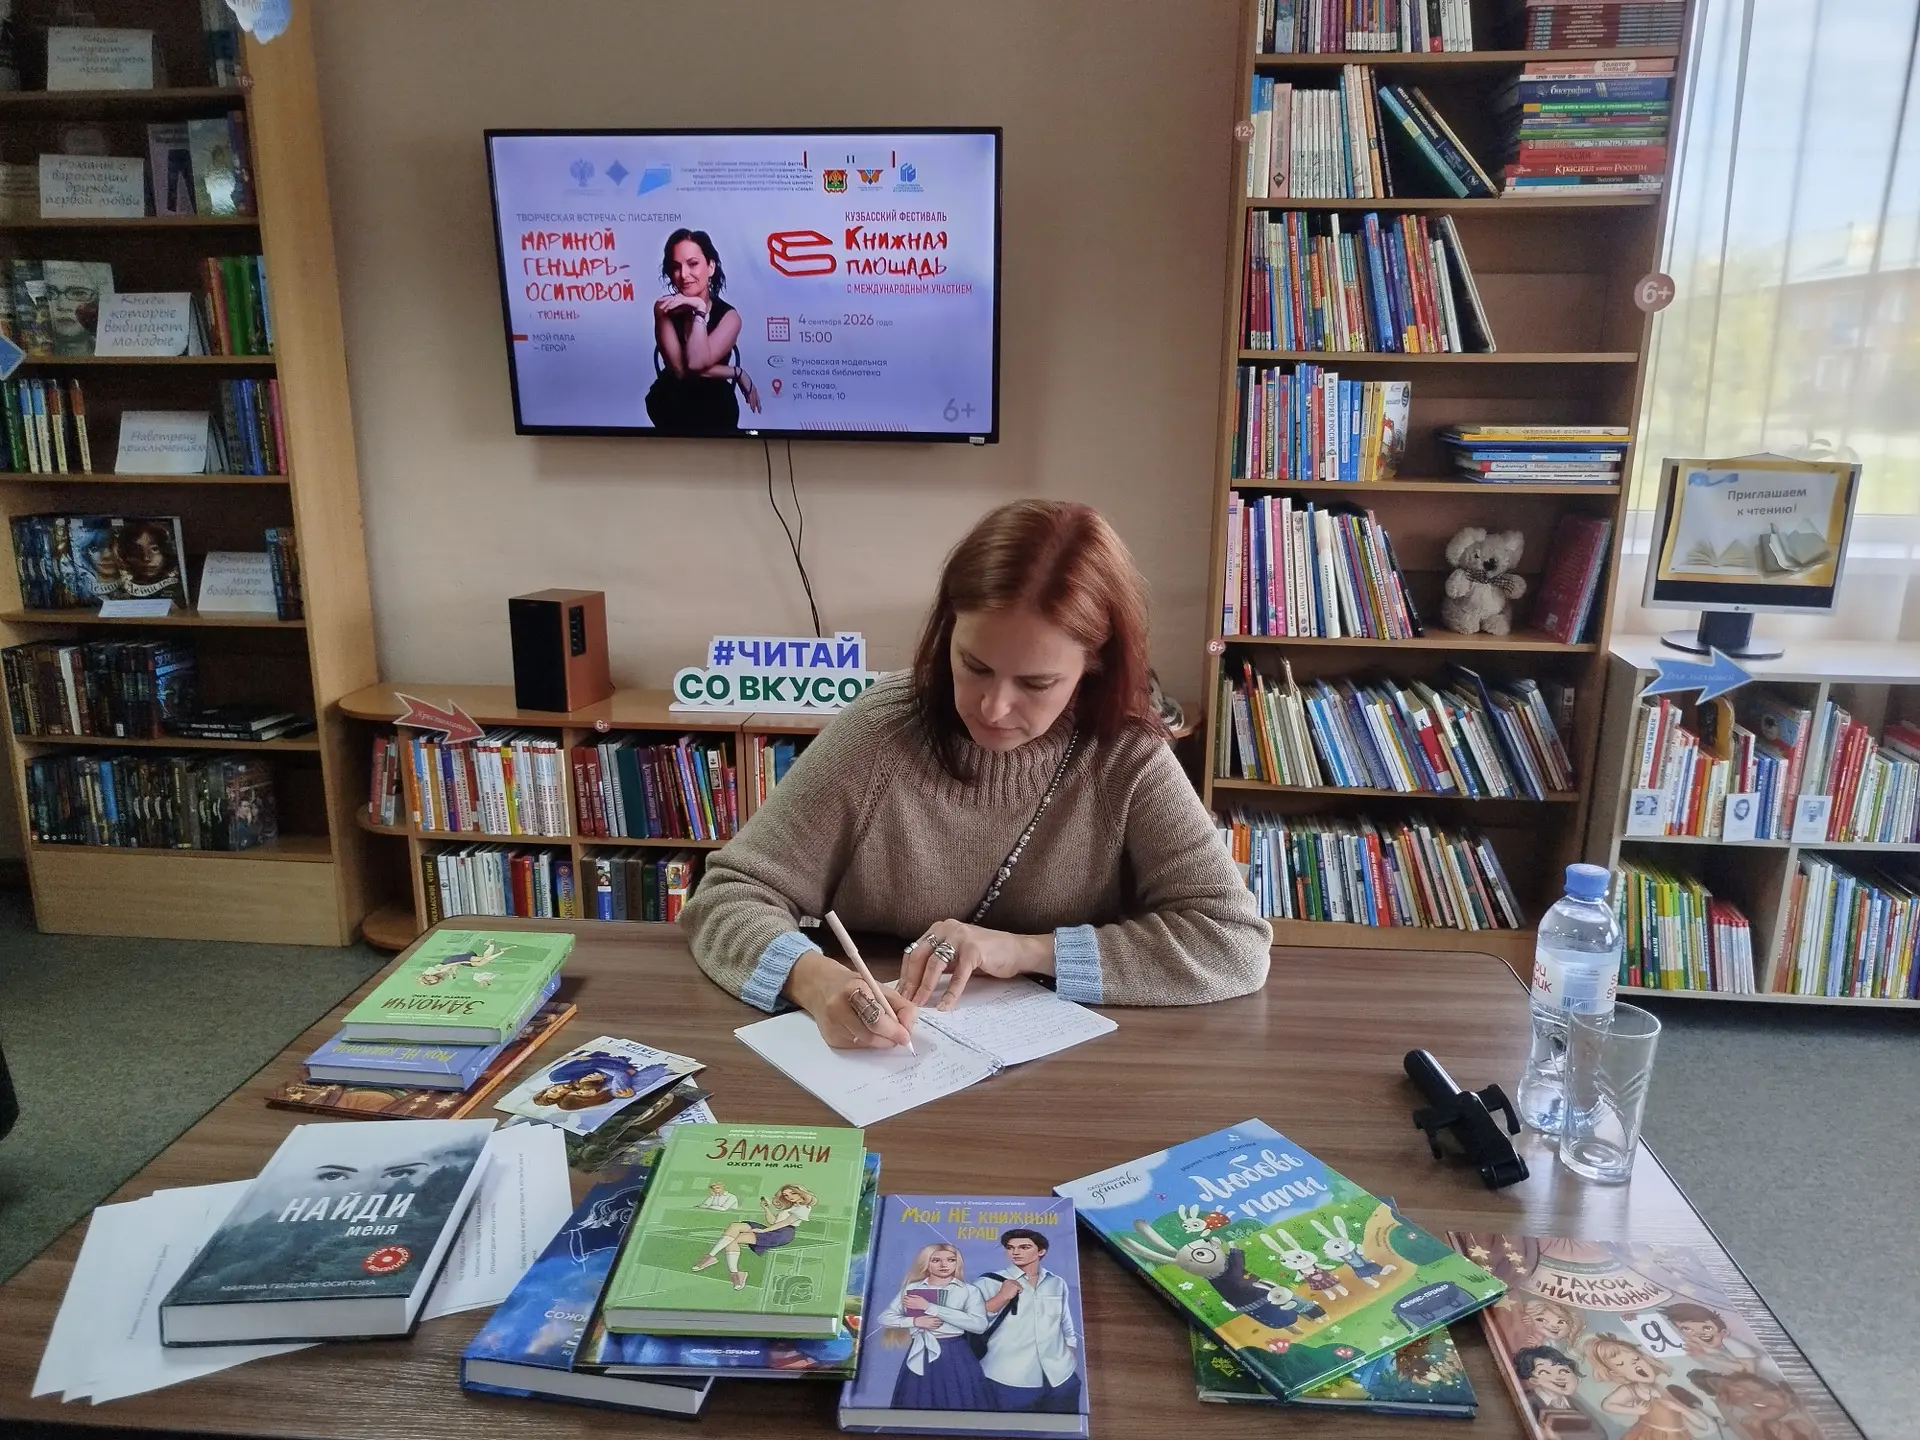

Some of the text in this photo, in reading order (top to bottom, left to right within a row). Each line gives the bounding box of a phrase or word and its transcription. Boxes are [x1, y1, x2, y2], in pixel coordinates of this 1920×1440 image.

[516, 213, 682, 222] ТВОРЧЕСКАЯ ВСТРЕЧА С ПИСАТЕЛЕМ
[845, 210, 947, 222] КУЗБАССКИЙ ФЕСТИВАЛЬ
[521, 228, 616, 251] МАРИНОЙ
[525, 279, 635, 301] ОСИПОВОЙ
[854, 284, 929, 295] МЕЖДУНАРОДНЫМ
[931, 284, 973, 294] УЧАСТИЕМ
[1642, 282, 1673, 304] 6+
[798, 314, 806, 325] 4
[843, 314, 874, 326] 2026
[799, 331, 833, 343] 15:00
[791, 358, 888, 367] Ягуновская модельная
[792, 368, 881, 376] сельская библиотека
[943, 398, 976, 422] 6+
[1728, 487, 1807, 501] Приглашаем
[1737, 504, 1798, 516] к чтению!
[713, 637, 860, 669] #ЧИТАЙ
[1209, 642, 1225, 653] 6+
[680, 674, 731, 701] СО
[596, 720, 611, 731] 6+
[380, 996, 486, 1015] ЗАМОЛЧИ
[401, 1048, 421, 1061] НЕ
[706, 1138, 831, 1163] ЗАМОЛЧИ
[1188, 1149, 1304, 1202] Любовь
[1091, 1171, 1142, 1205] детство
[1239, 1176, 1328, 1217] папы
[277, 1192, 416, 1223] НАЙДИ
[948, 1207, 972, 1224] НЕ
[345, 1224, 399, 1237] меня
[1552, 1273, 1634, 1290] ТАКОЙ
[1536, 1281, 1666, 1307] НИКАЛЬНЫЙ
